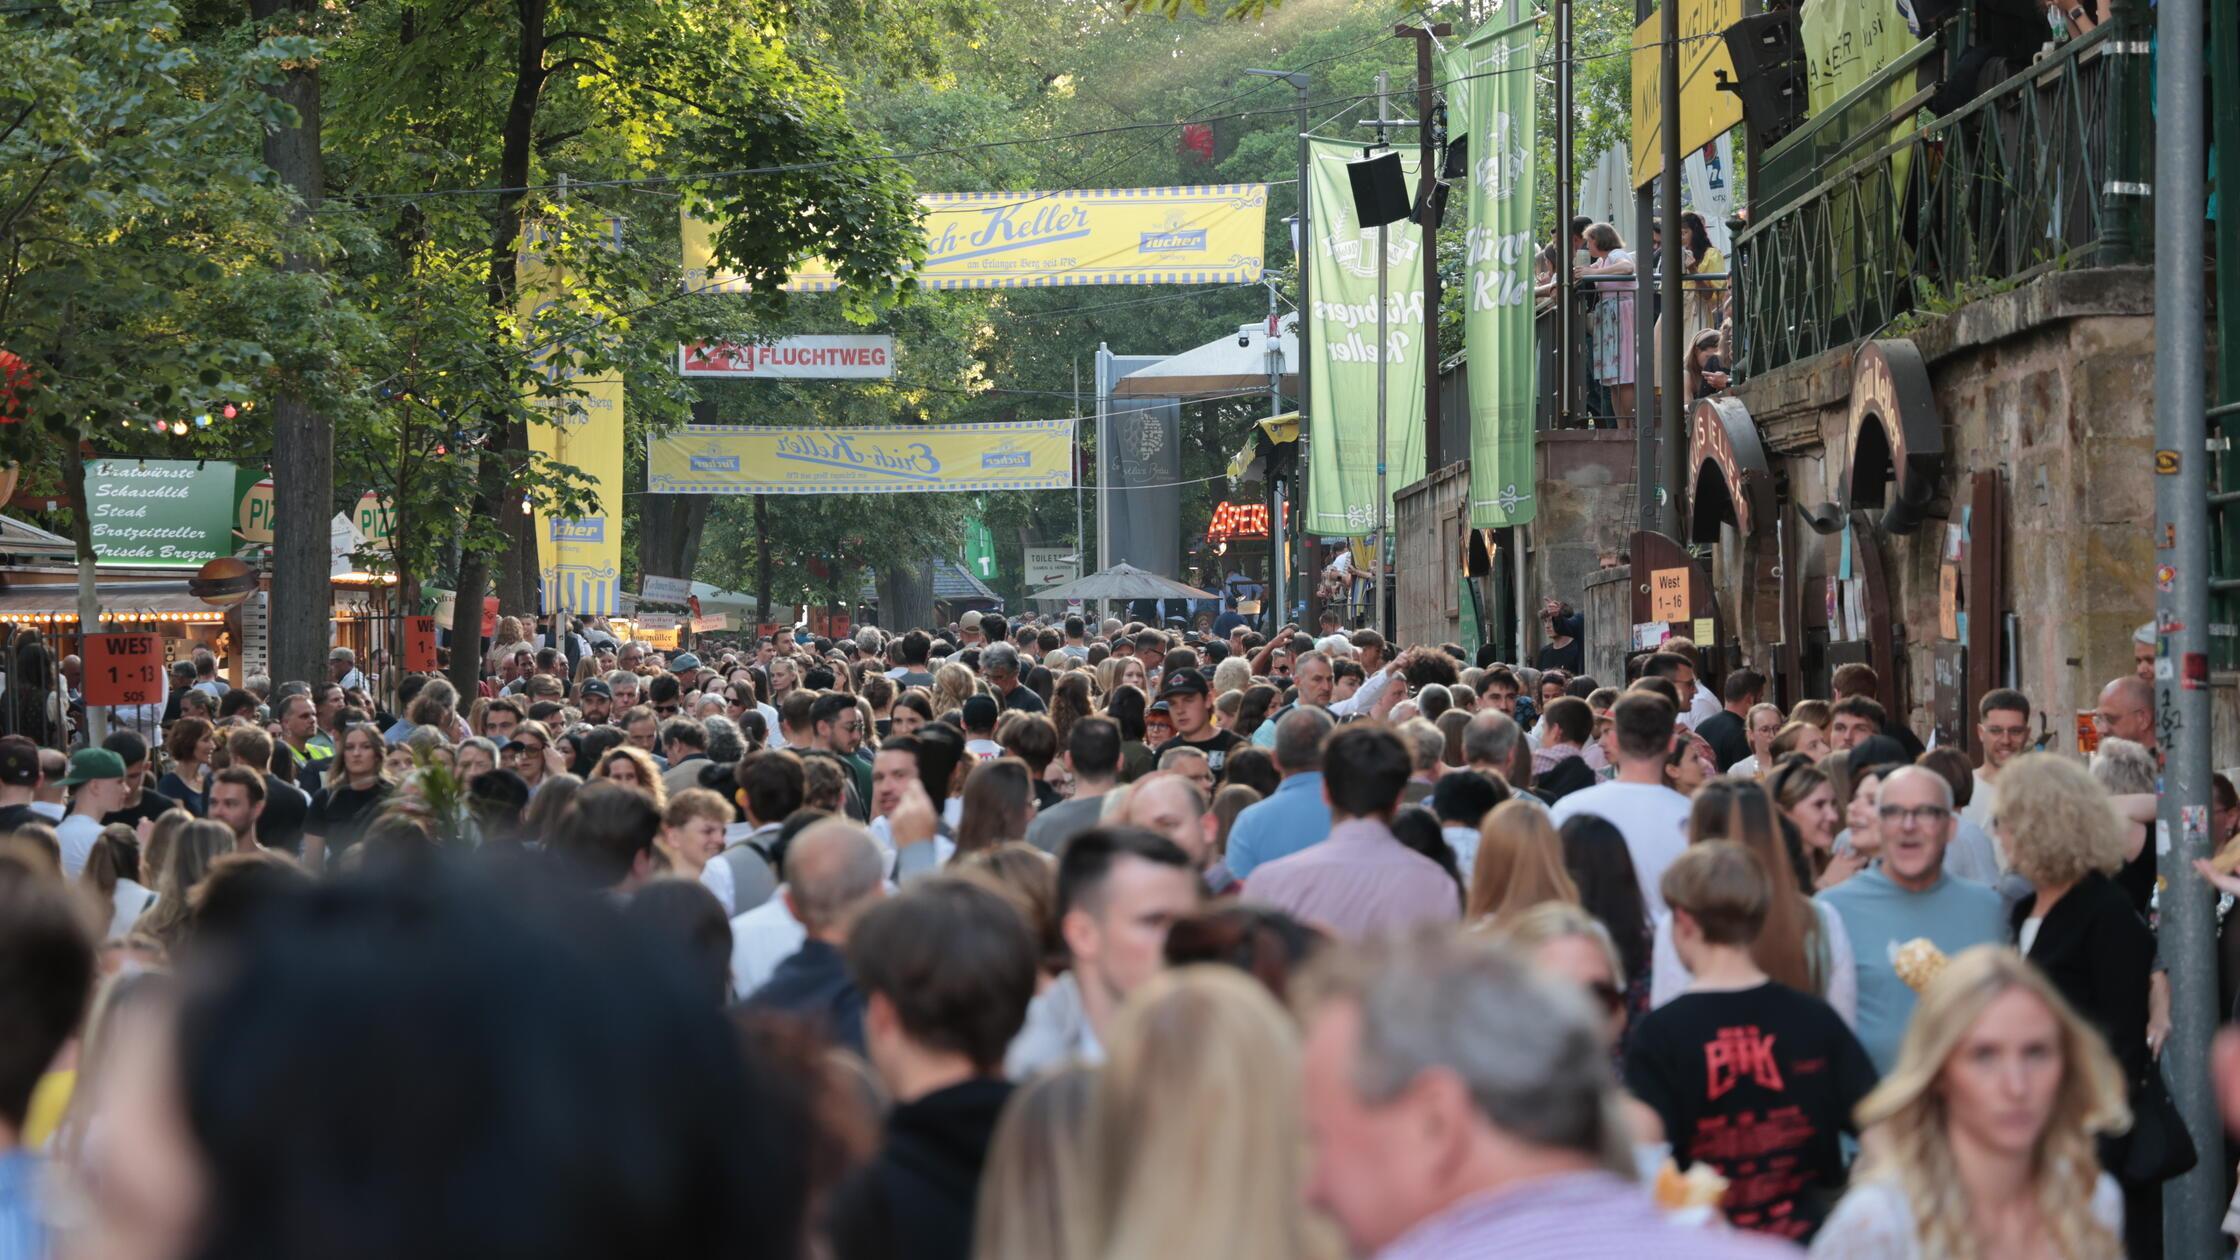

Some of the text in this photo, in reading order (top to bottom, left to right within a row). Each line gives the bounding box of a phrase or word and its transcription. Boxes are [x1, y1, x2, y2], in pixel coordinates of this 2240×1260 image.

[1642, 64, 1661, 129] NIK
[926, 202, 1089, 255] ch-Keller
[759, 347, 885, 366] FLUCHTWEG
[95, 484, 190, 499] Schaschlik
[94, 504, 147, 518] Steak
[251, 498, 274, 530] PIZ
[92, 523, 206, 542] Brotzeitteller
[361, 509, 400, 538] PIZZ
[91, 545, 217, 562] Frische Brezen
[1659, 575, 1680, 589] West
[1673, 595, 1682, 608] 16
[417, 620, 435, 633] WE
[106, 637, 153, 655] WEST
[108, 668, 117, 683] 1
[140, 665, 154, 682] 13
[123, 691, 145, 702] SOS
